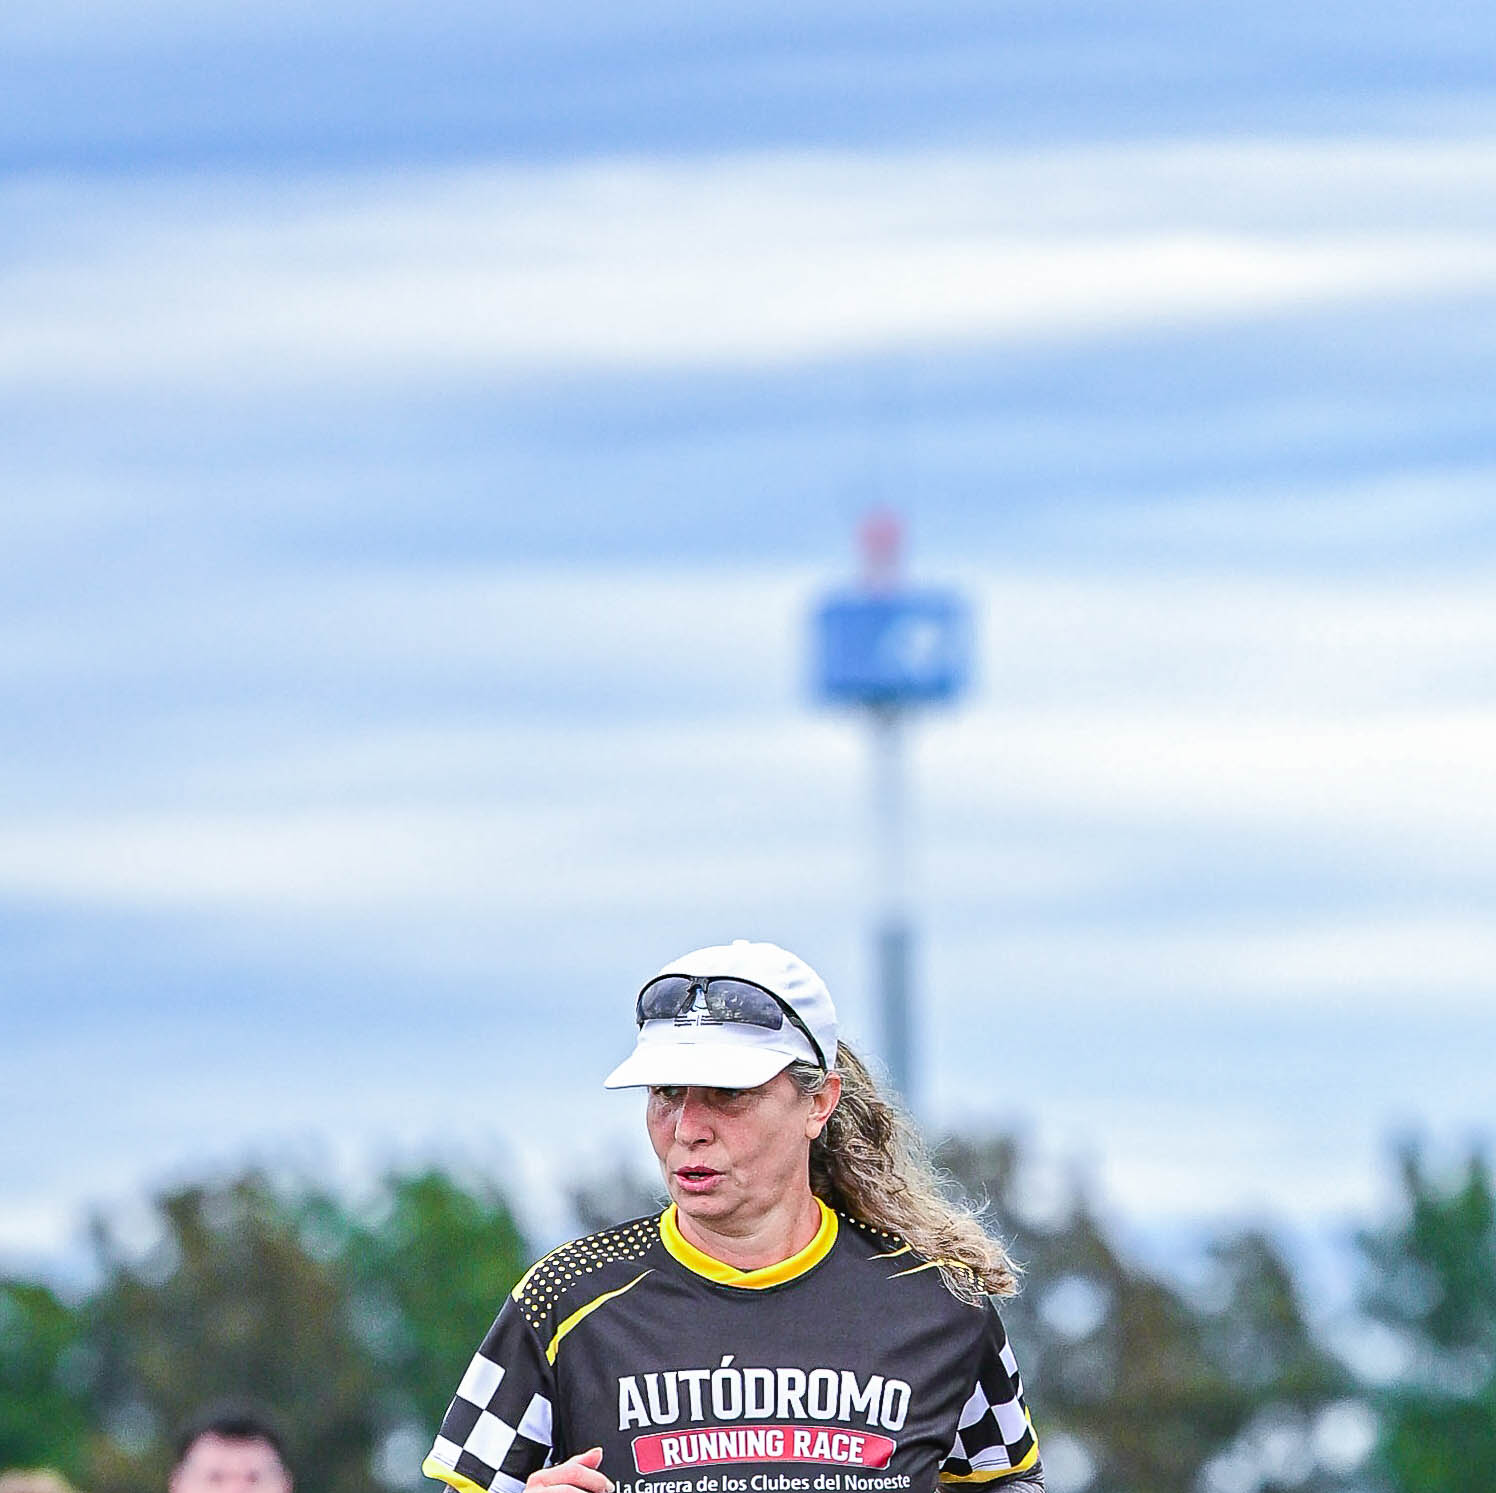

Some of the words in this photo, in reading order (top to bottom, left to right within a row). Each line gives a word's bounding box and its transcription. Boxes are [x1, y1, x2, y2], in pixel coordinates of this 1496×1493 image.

[618, 1355, 912, 1431] AUTÓDROMO
[661, 1430, 785, 1467] RUNNING
[793, 1430, 865, 1464] RACE
[696, 1475, 719, 1492] de
[722, 1475, 747, 1492] los
[751, 1474, 810, 1491] Clubes
[813, 1473, 841, 1490] del
[844, 1474, 911, 1491] Noroeste
